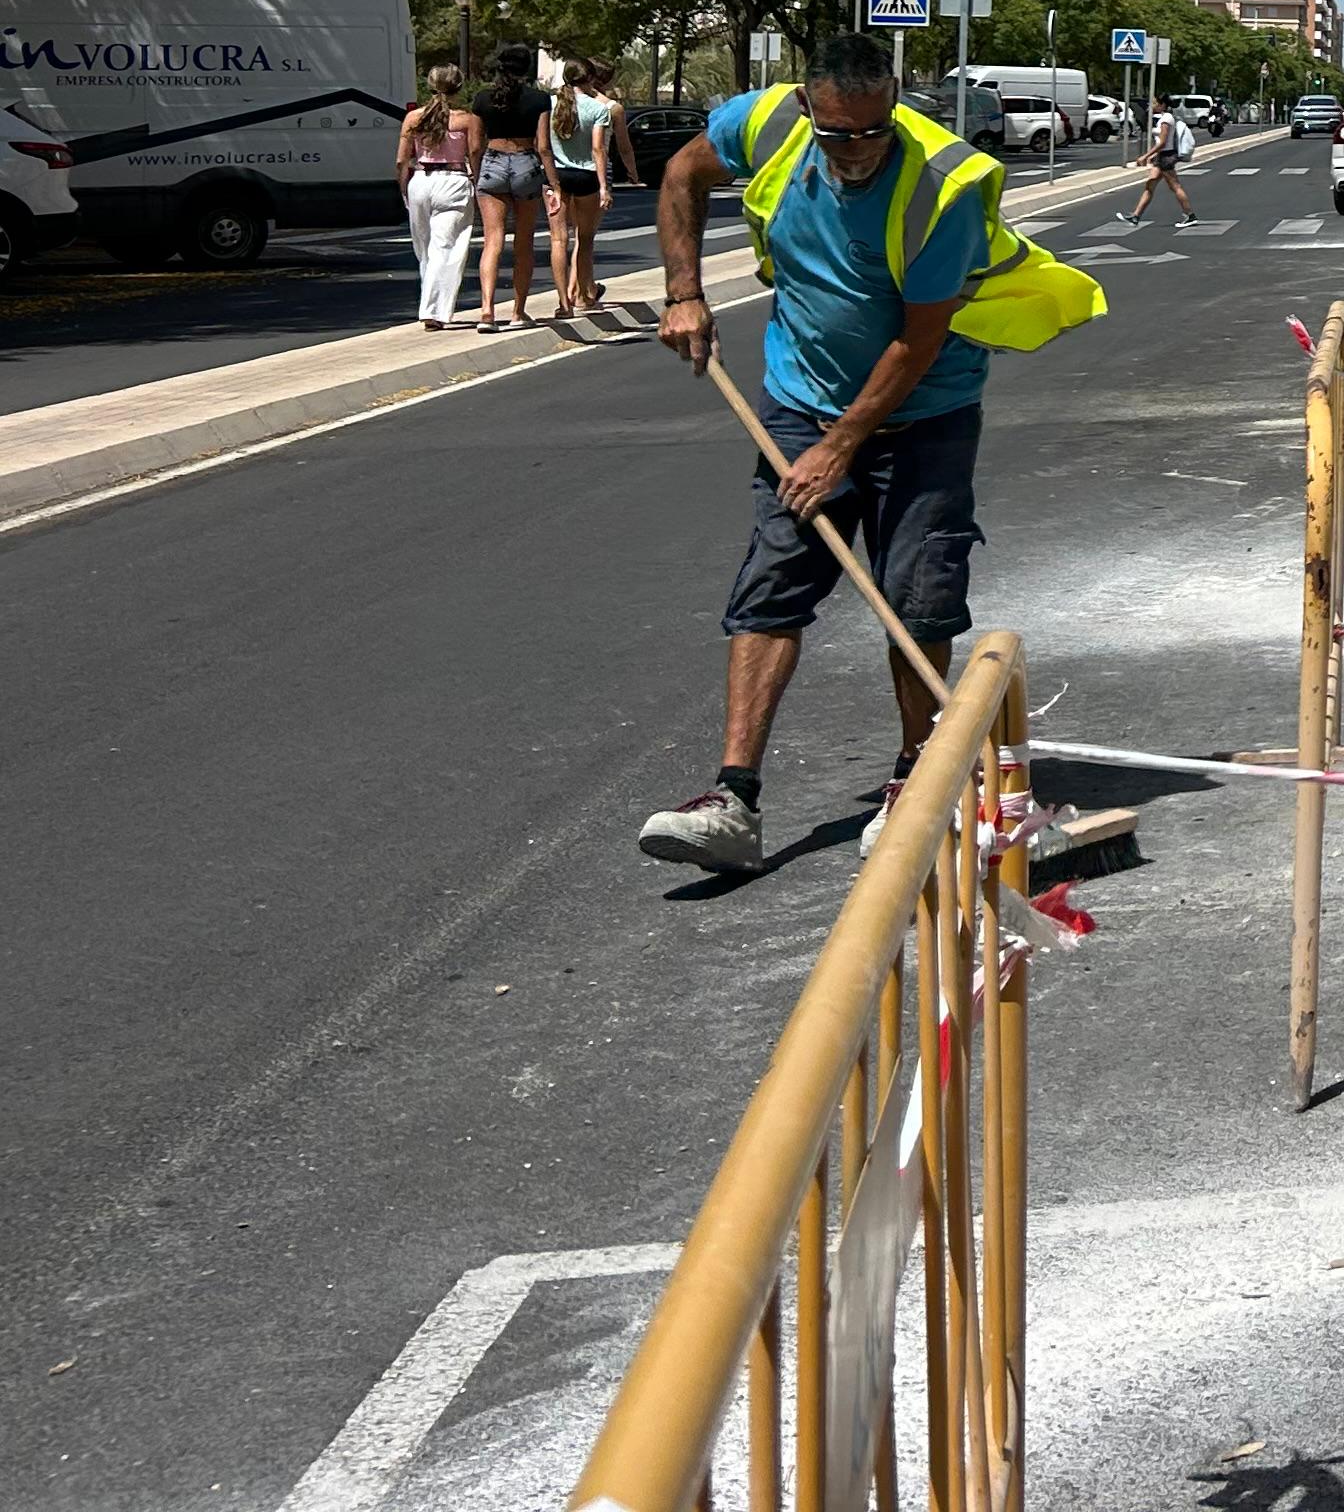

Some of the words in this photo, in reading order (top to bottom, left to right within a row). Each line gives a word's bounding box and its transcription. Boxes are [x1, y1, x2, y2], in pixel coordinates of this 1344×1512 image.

[281, 59, 311, 72] S.L.
[55, 75, 123, 87] EMPRESA
[127, 74, 242, 87] CONSTRUCTORA
[127, 149, 322, 166] www.involucrasl.es
